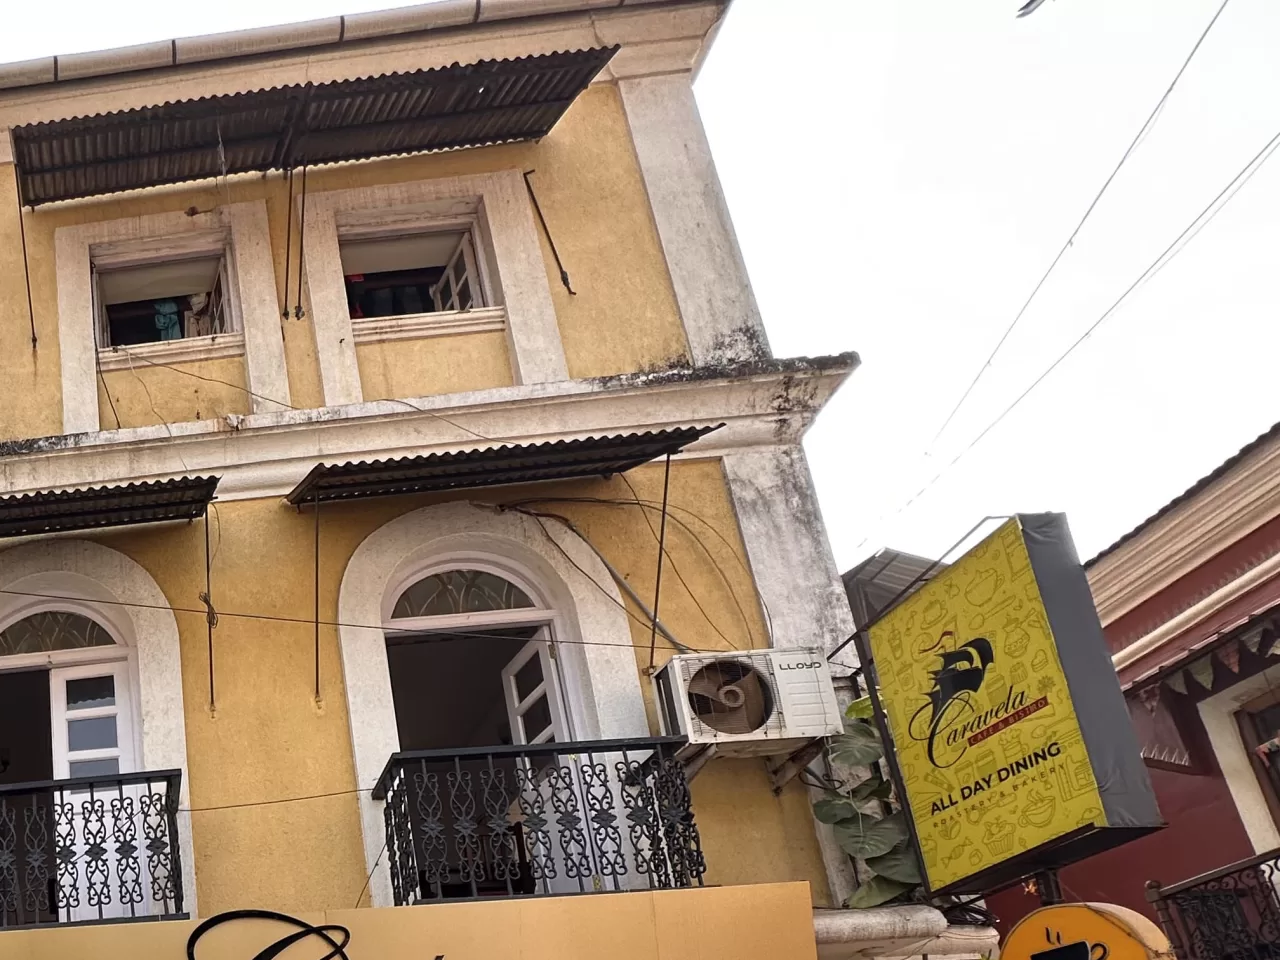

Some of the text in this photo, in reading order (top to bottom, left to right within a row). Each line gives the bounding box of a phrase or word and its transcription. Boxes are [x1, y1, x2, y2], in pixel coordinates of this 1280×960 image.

[779, 662, 822, 670] LLOYD
[908, 684, 1026, 768] Caravela
[970, 728, 994, 744] CAFE
[1008, 700, 1046, 724] BISTRO
[931, 742, 1061, 815] ALL DAY DINING
[933, 797, 992, 828] ROASTERY
[1012, 763, 1064, 791] BAKERY
